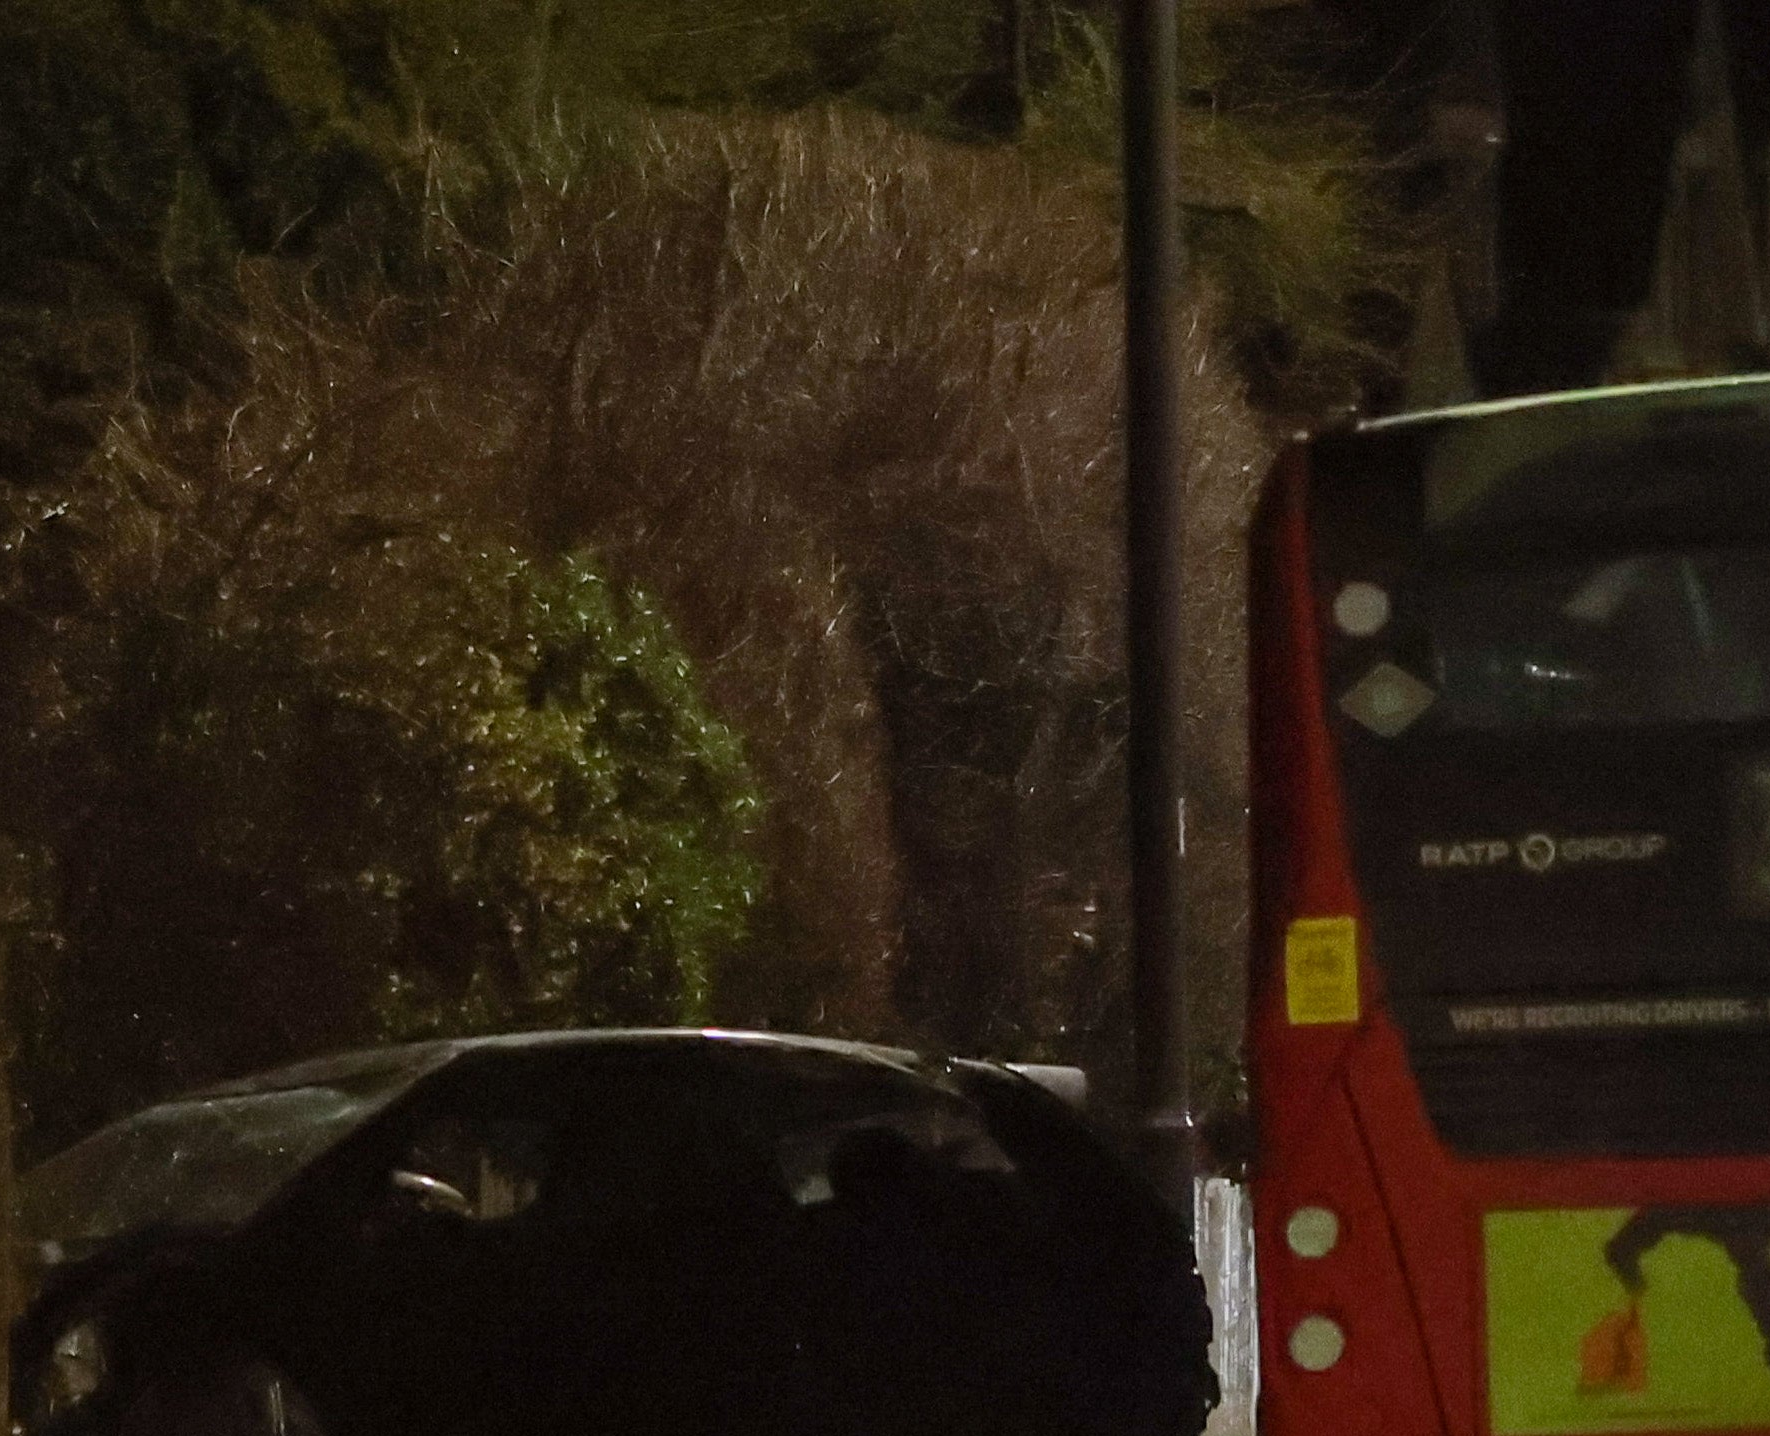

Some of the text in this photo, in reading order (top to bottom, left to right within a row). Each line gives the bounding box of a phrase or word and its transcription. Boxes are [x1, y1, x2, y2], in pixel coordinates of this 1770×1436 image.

[1420, 833, 1667, 868] RATP GROUP
[1524, 1001, 1651, 1030] RECRUITING
[1654, 997, 1750, 1025] DRIVERS
